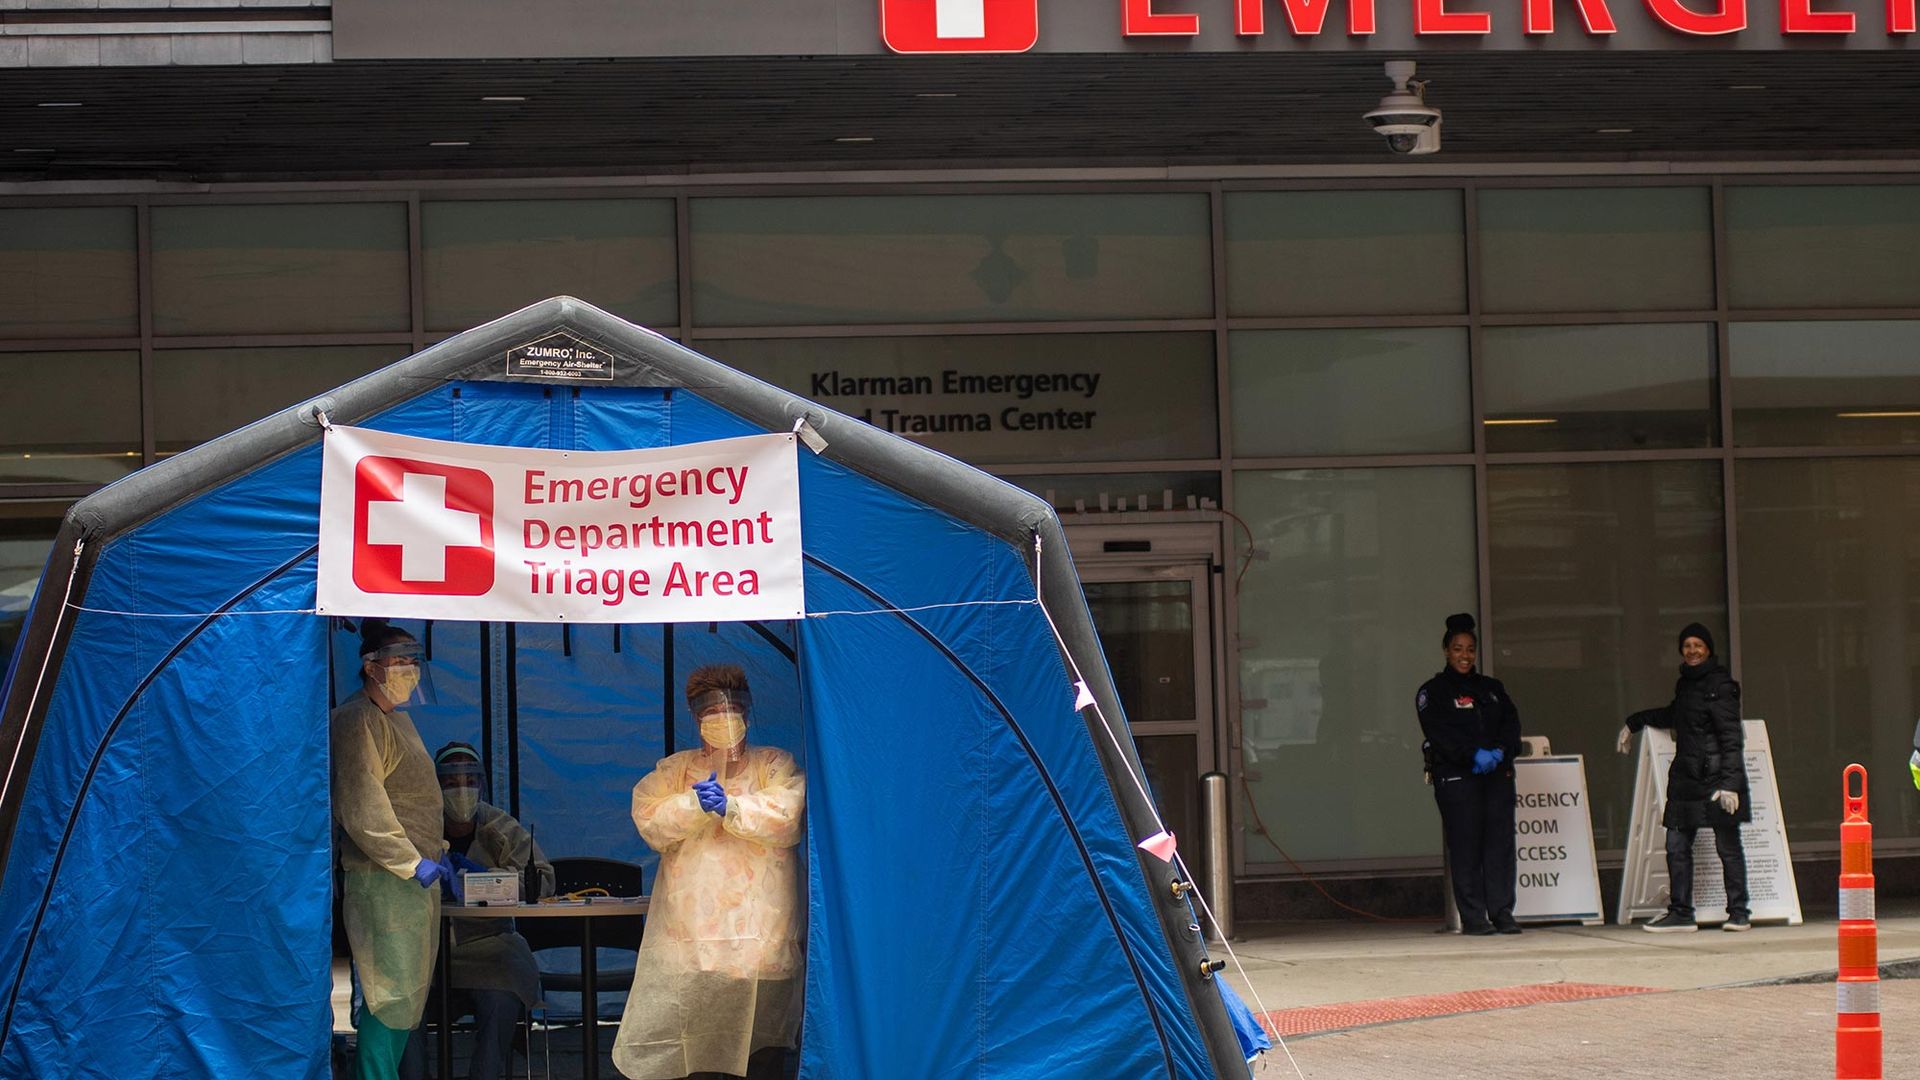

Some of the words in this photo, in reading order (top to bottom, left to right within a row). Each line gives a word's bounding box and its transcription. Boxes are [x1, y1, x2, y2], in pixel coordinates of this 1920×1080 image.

[576, 349, 595, 359] Inc.
[520, 358, 561, 368] Emergency
[811, 371, 932, 397] Klarman
[942, 370, 1100, 399] Emergency
[881, 409, 992, 433] Trauma
[1001, 407, 1097, 432] Center
[524, 466, 749, 508] Emergency
[523, 511, 774, 557] Department
[523, 560, 650, 606] Triage
[662, 562, 760, 597] Area
[1515, 792, 1580, 808] RGENCY
[1514, 819, 1559, 835] OOM
[1515, 845, 1568, 862] CCESS
[1518, 872, 1560, 888] ONLY
